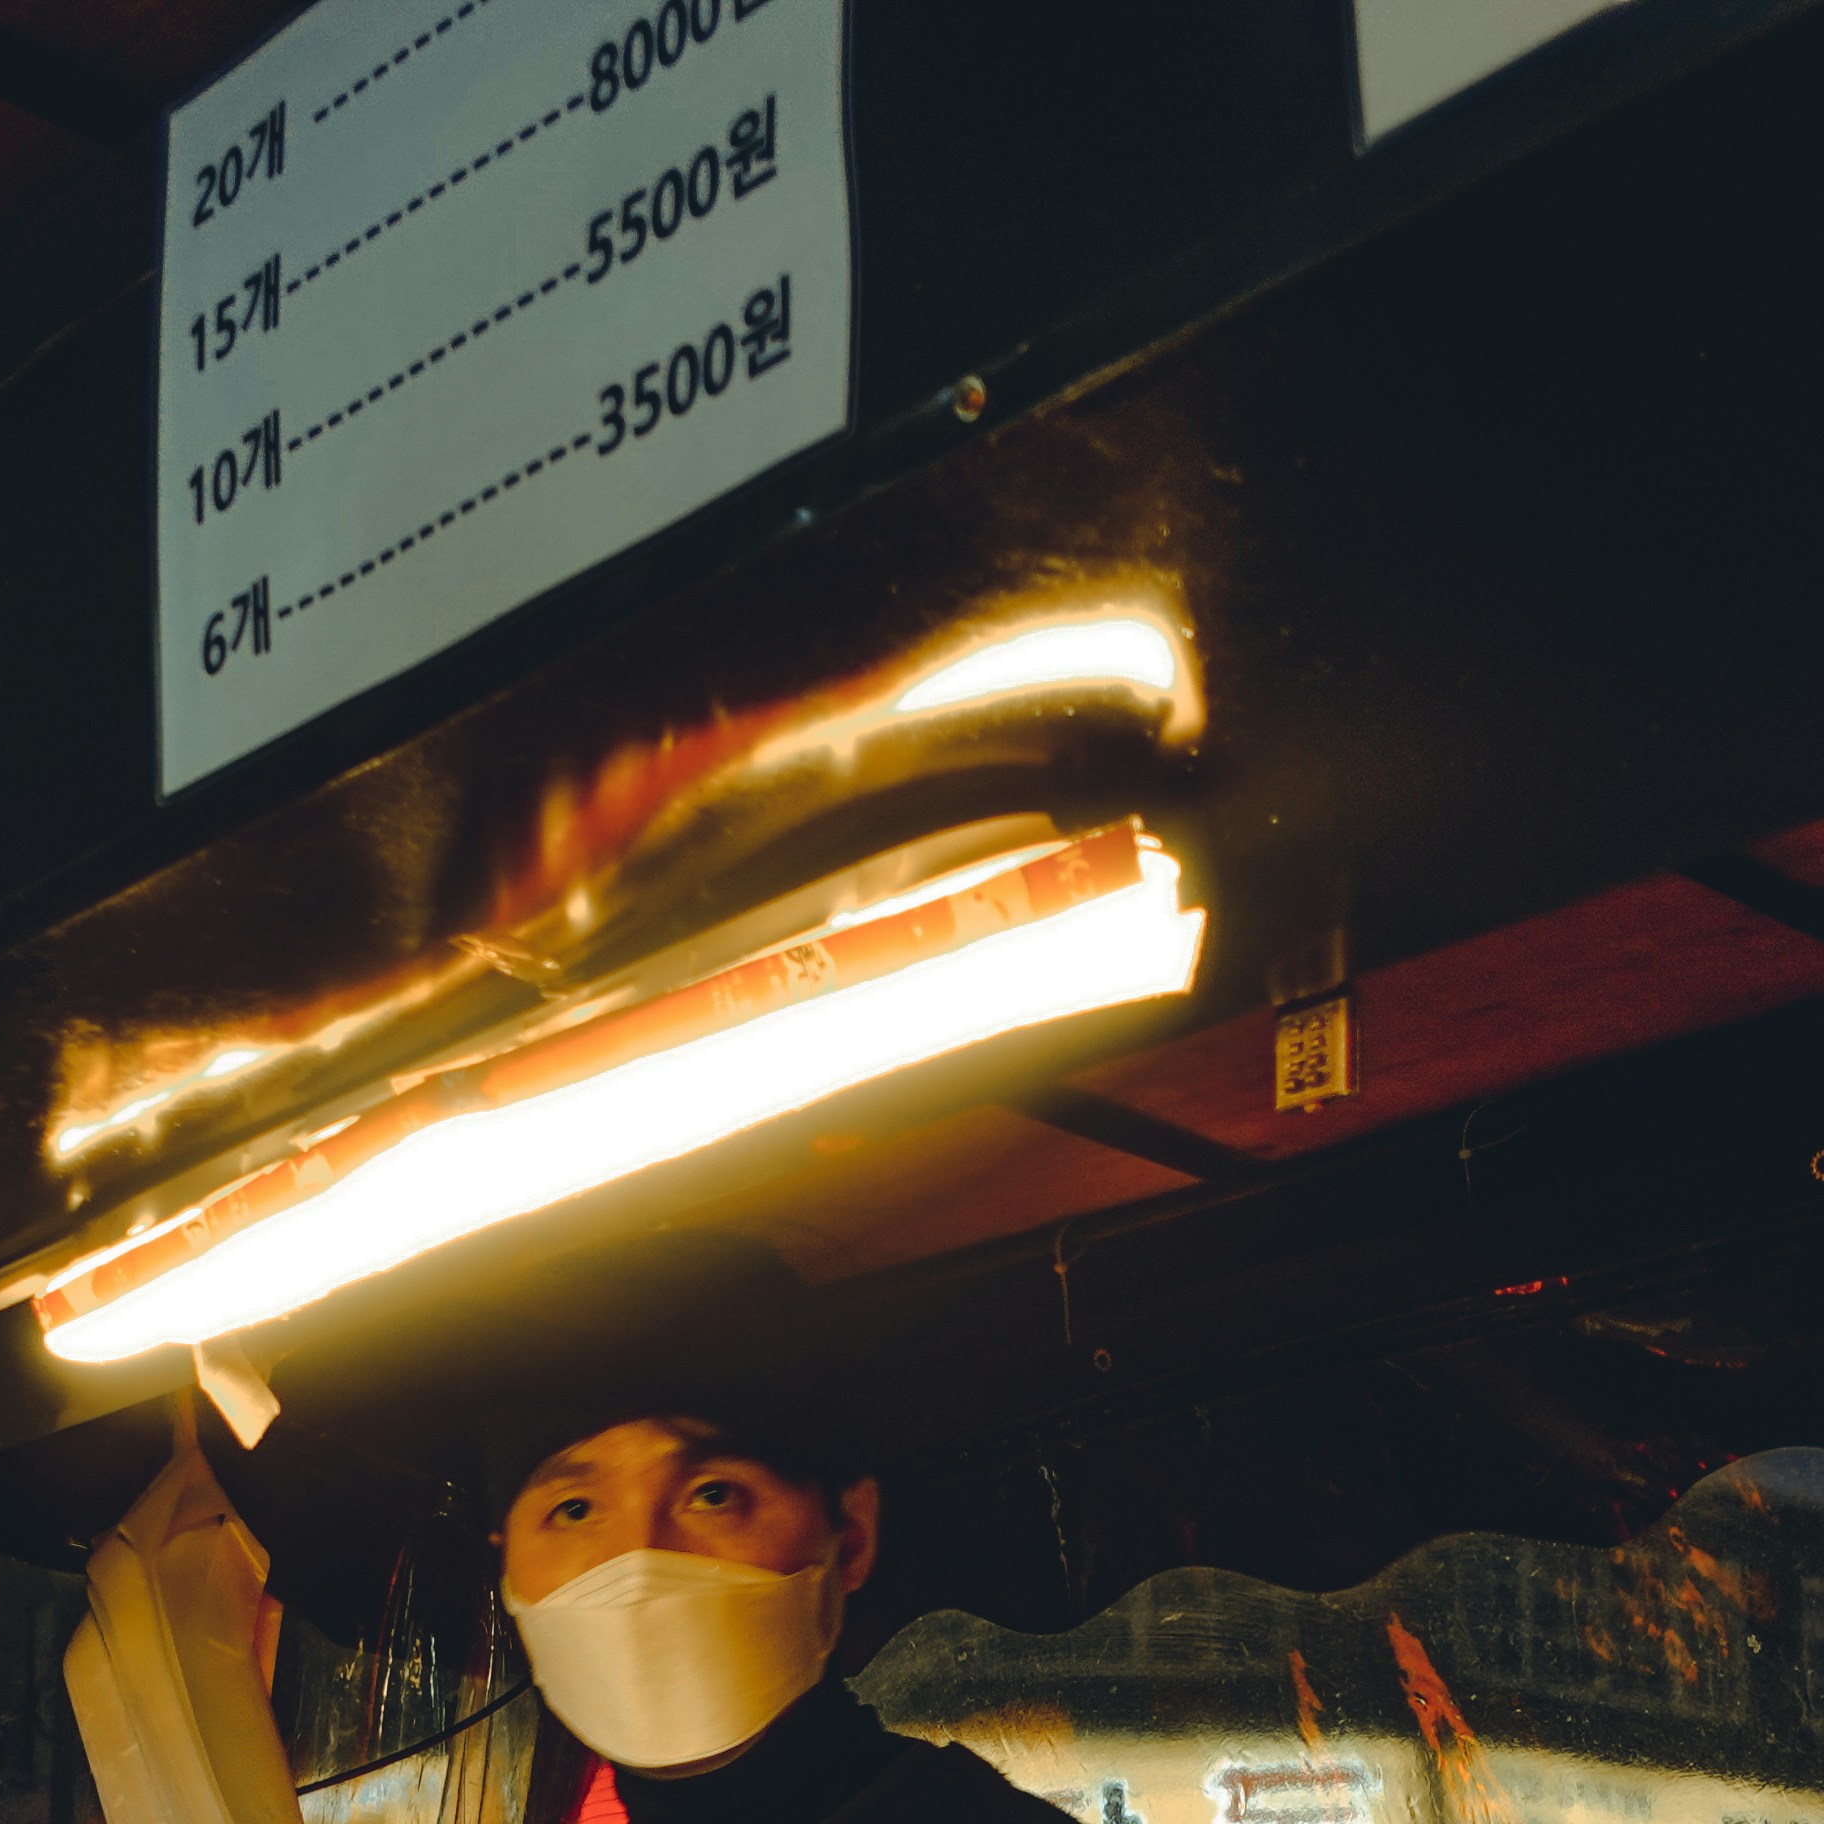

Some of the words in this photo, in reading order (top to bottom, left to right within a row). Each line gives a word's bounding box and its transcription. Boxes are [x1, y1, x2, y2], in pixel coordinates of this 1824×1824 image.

[192, 100, 286, 229] 20개
[189, 409, 281, 525] 10개
[586, 94, 777, 284] 5500원
[190, 253, 281, 372] 15개
[202, 576, 271, 676] 6개
[597, 274, 790, 456] 3500원
